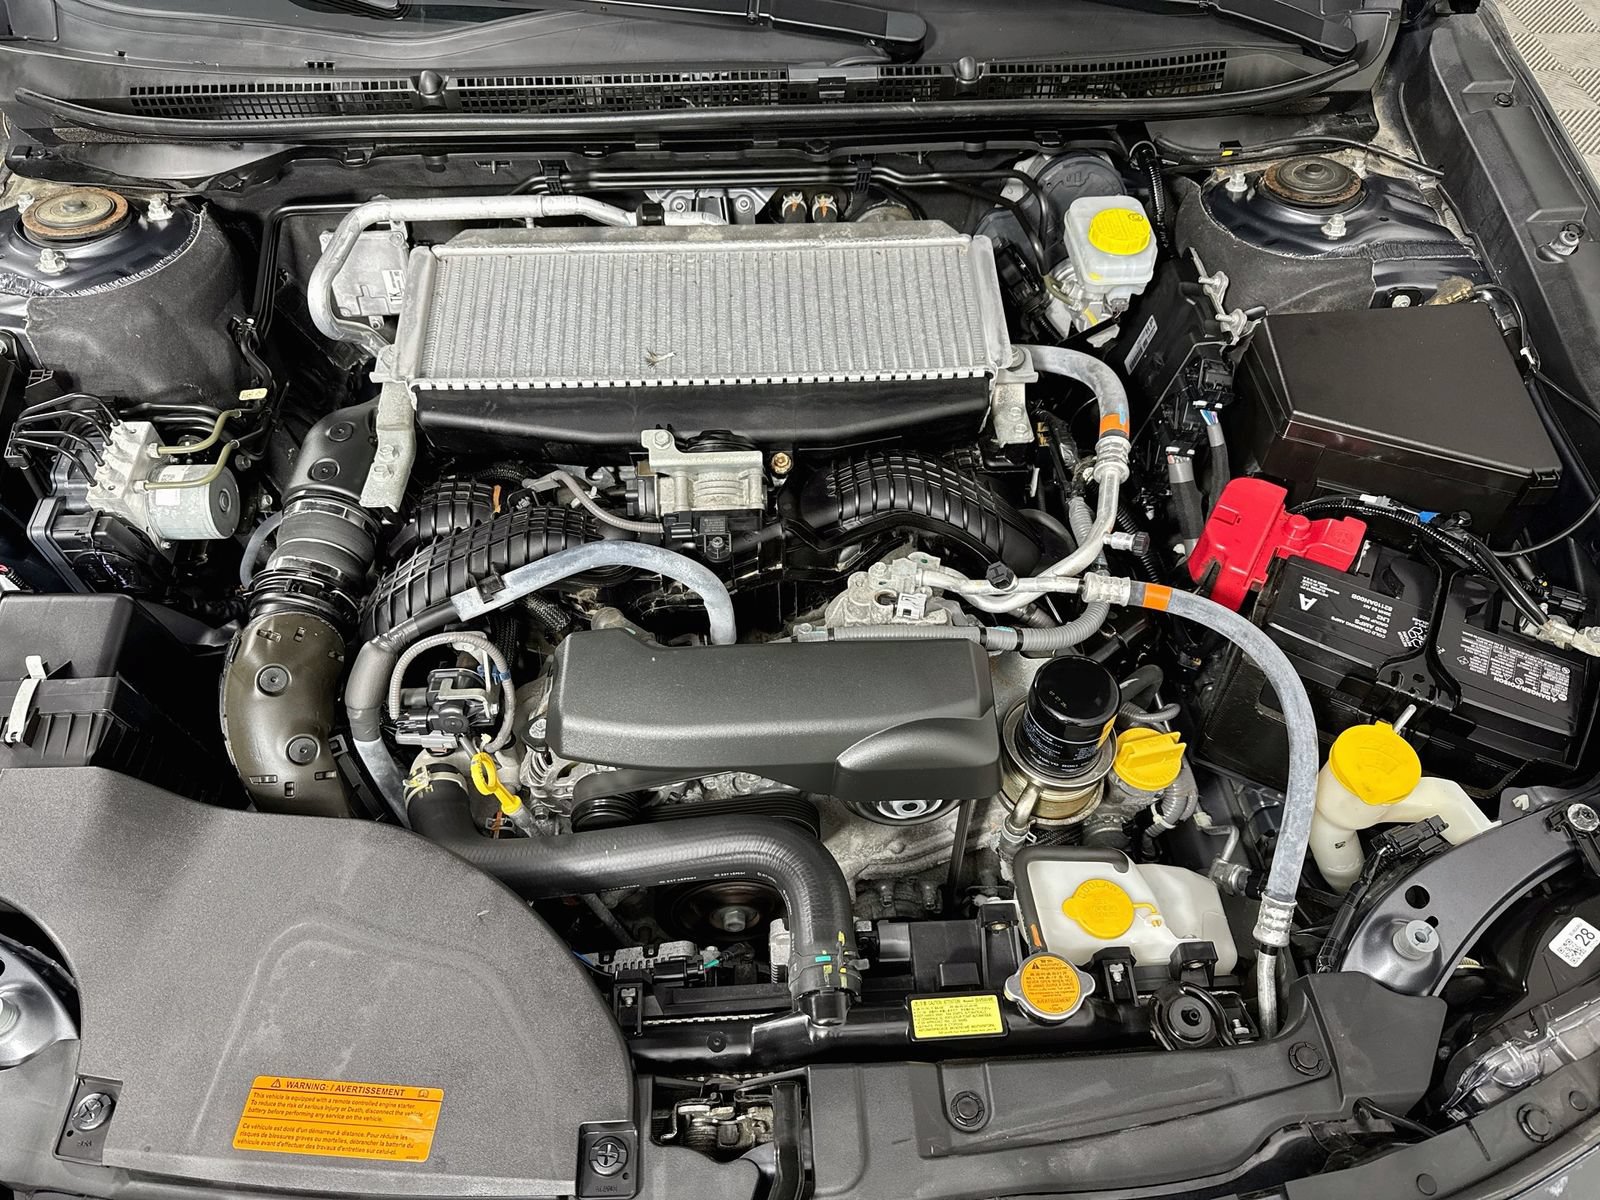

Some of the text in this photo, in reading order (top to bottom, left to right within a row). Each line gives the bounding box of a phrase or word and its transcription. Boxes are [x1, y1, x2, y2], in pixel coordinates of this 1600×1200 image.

[1294, 592, 1318, 613] A
[1330, 615, 1345, 624] AMPS
[1354, 618, 1375, 630] AMPS
[1345, 621, 1372, 634] CRANKING
[1371, 630, 1386, 639] COLD
[1493, 676, 1551, 700] DANGER/POISON
[1575, 928, 1595, 947] 28
[286, 1081, 328, 1091] WARNING:
[335, 1085, 405, 1096] AVERTISSEMENT
